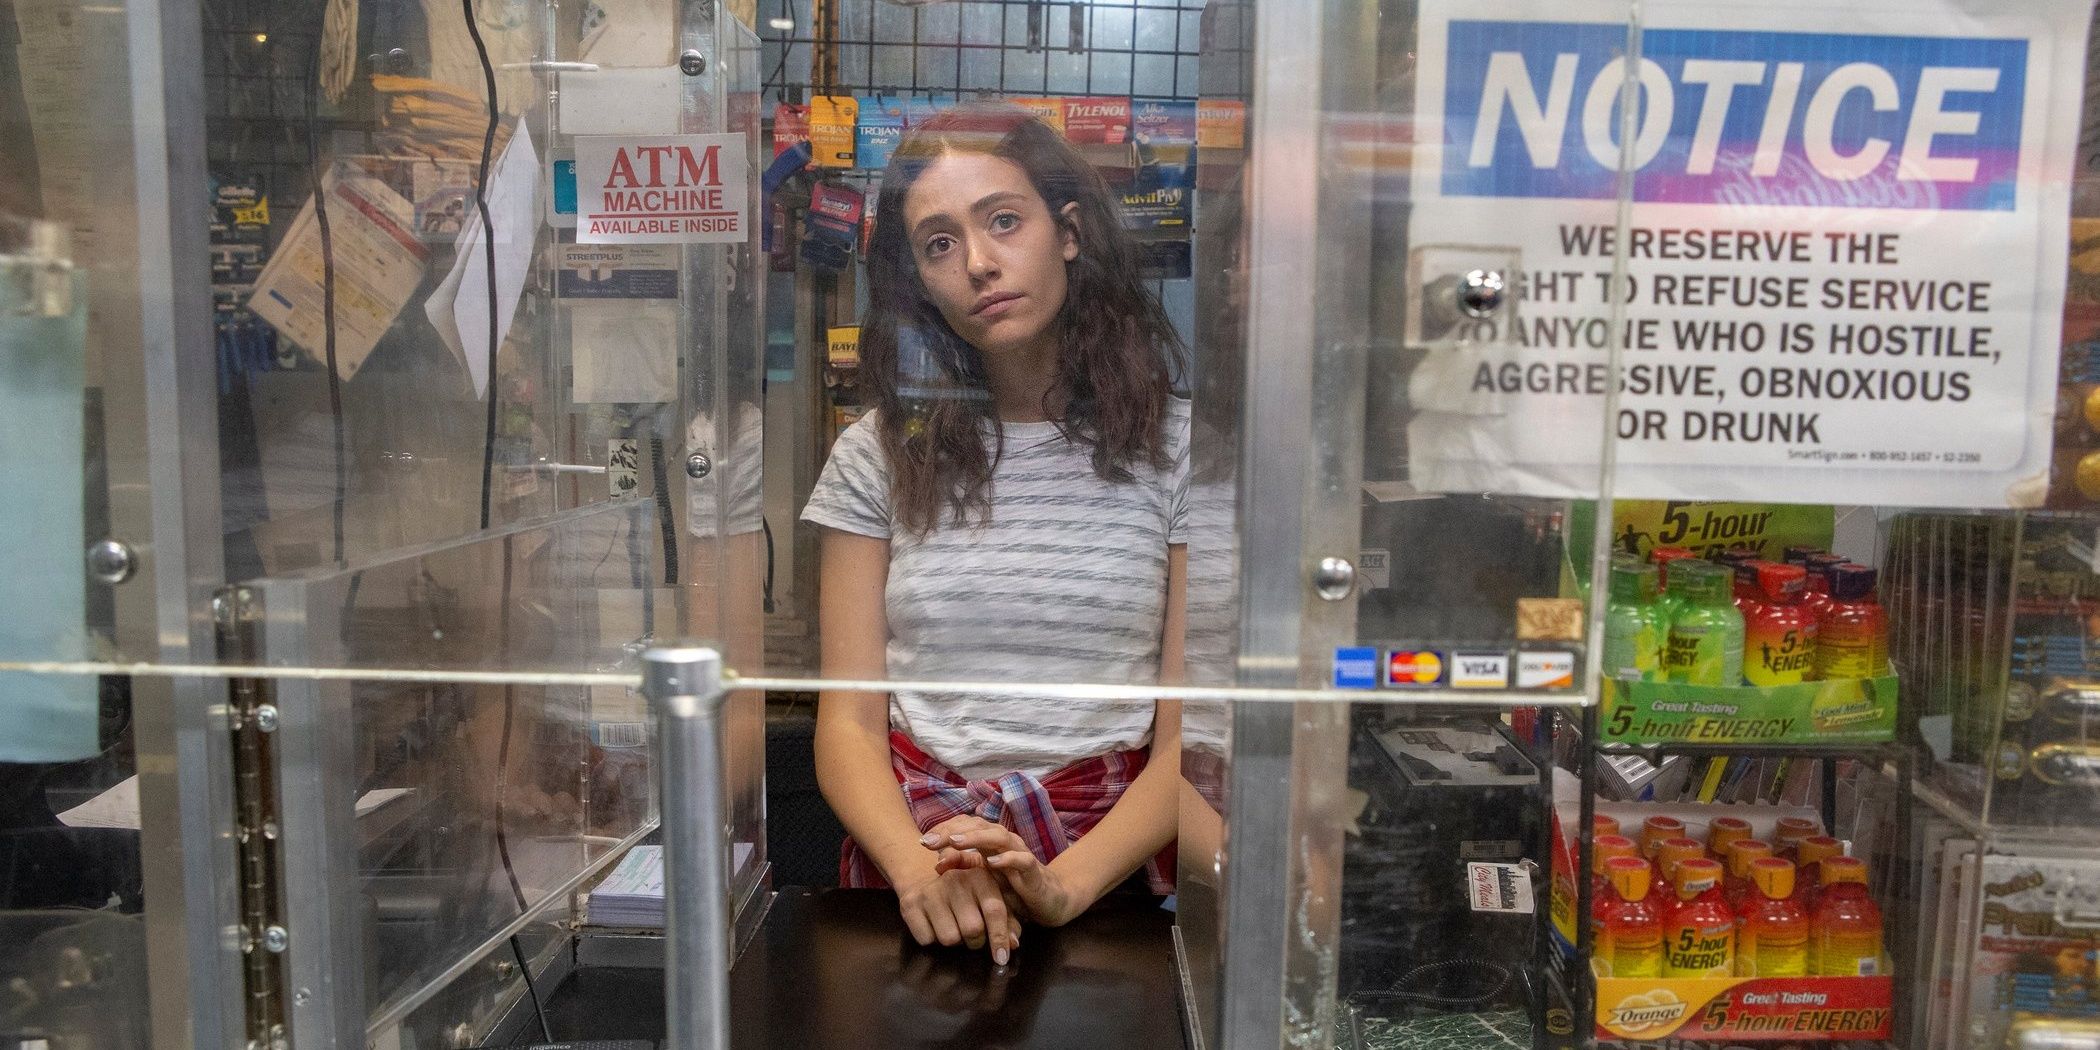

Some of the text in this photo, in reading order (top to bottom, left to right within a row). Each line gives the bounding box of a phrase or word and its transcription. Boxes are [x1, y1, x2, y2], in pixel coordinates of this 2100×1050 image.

[1067, 103, 1126, 118] TYLENOL
[1468, 51, 2001, 183] NOTICE
[813, 124, 850, 135] TROJAN
[858, 126, 900, 137] TROJAN
[603, 145, 724, 189] ATM
[604, 189, 723, 212] MACHINE
[590, 218, 738, 234] AVAILABLE INSIDE
[1559, 224, 1899, 265] WE RESERVE THE
[566, 253, 624, 261] STREETPLUS
[1653, 275, 1809, 309] REFUSE
[1821, 278, 1991, 313] SERVICE
[1673, 320, 1766, 353] WHO
[1780, 322, 1815, 354] IS
[1829, 324, 2001, 365] HOSTILE,
[1740, 366, 1971, 402] OBNOXIOUS
[1617, 409, 1821, 444] OR DRUNK
[1658, 500, 1774, 544] 5-hour
[1462, 660, 1501, 677] VISA
[1650, 700, 1739, 715] Great Tasting
[1607, 705, 1795, 740] 5-hour ENERGY
[1474, 866, 1491, 884] City
[1678, 929, 1728, 952] 5-hour
[1671, 952, 1728, 969] ENERGY
[1782, 991, 1827, 1006] Tasting
[1619, 1006, 1681, 1028] Orange
[1701, 999, 1888, 1033] 5-hour ENERGY
